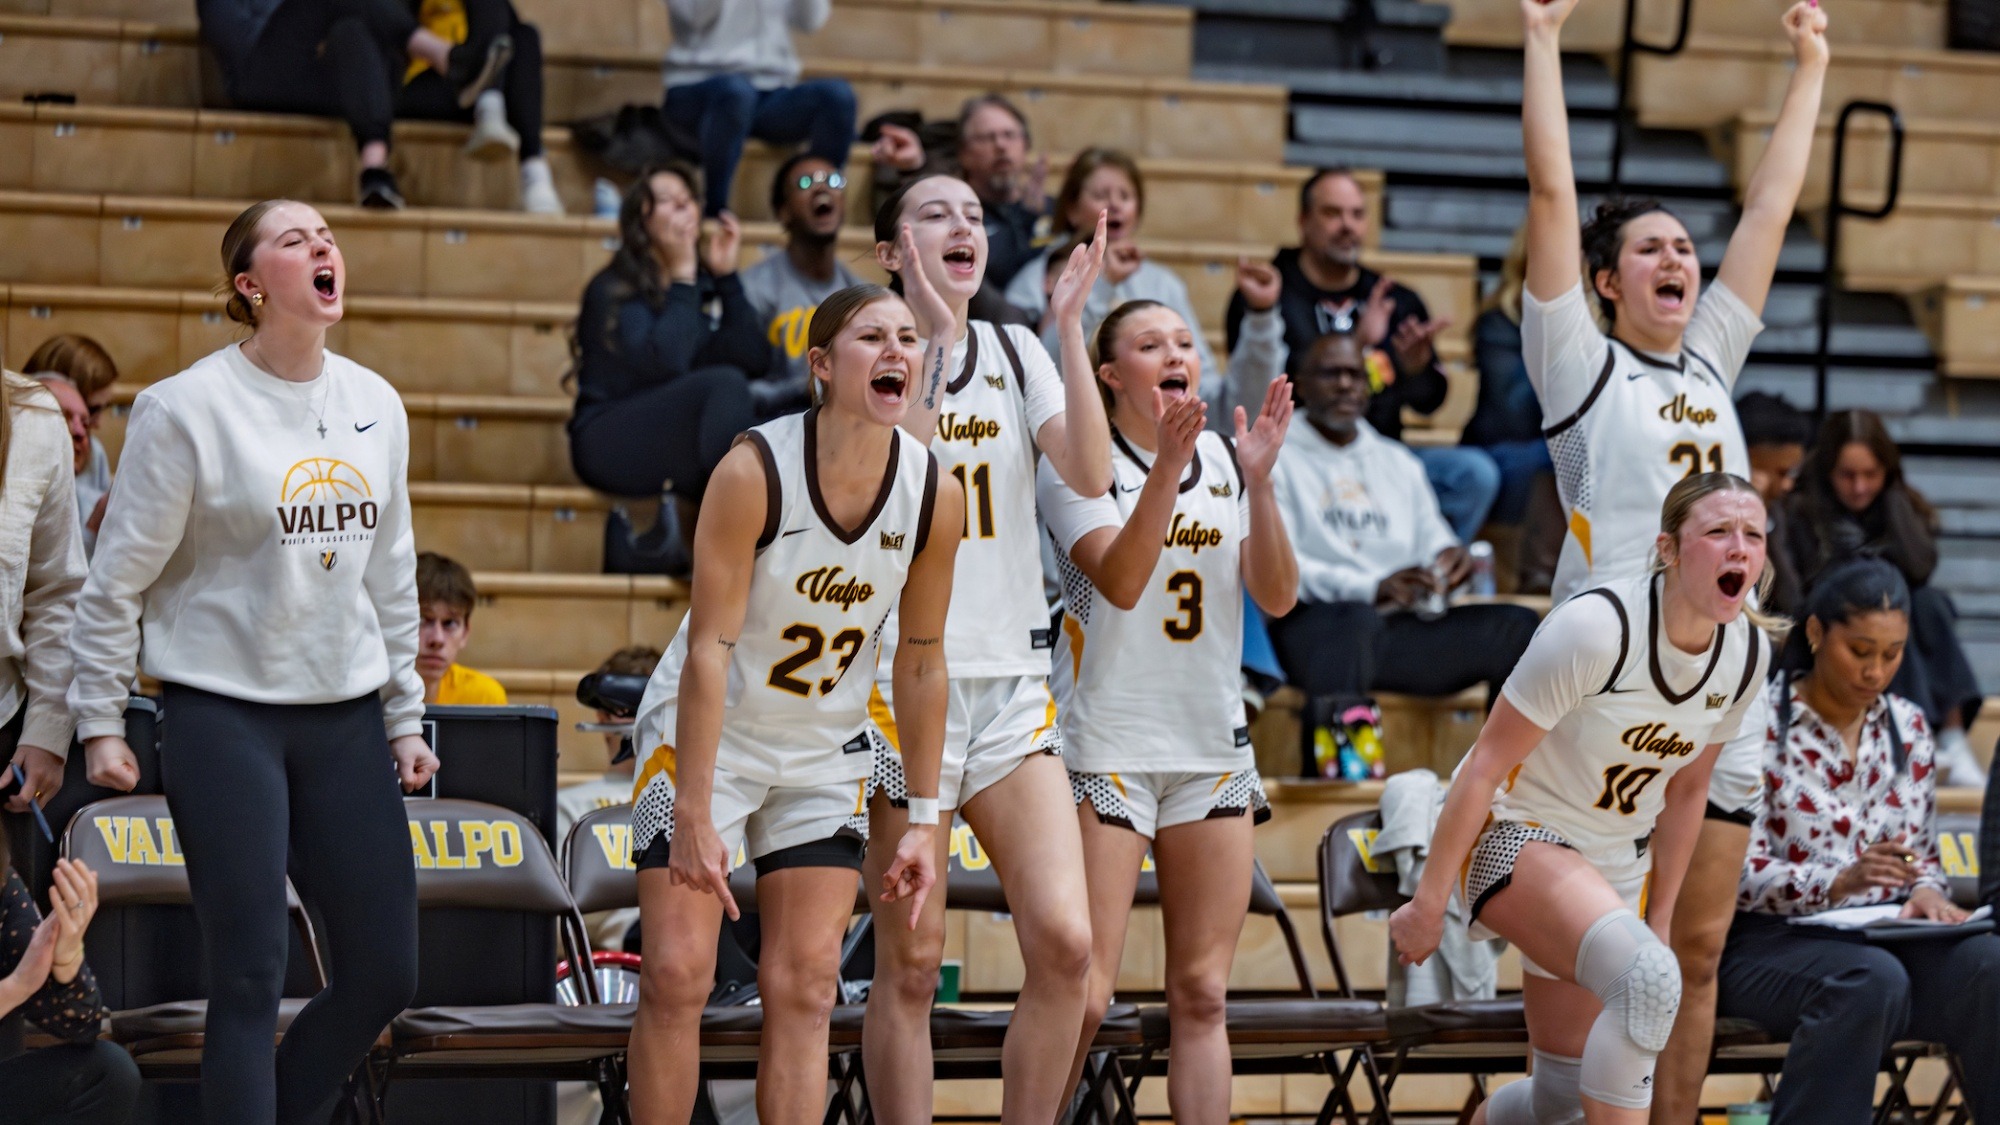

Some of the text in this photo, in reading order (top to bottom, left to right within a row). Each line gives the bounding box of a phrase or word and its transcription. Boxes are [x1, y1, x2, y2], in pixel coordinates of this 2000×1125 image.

[277, 501, 378, 534] VALPO
[795, 565, 874, 613] Valpo
[1163, 570, 1203, 643] 3
[765, 621, 867, 699] 23
[1621, 722, 1695, 760] Valpo
[1592, 763, 1662, 817] 10
[93, 816, 186, 866] VAL
[408, 820, 524, 869] ALPO
